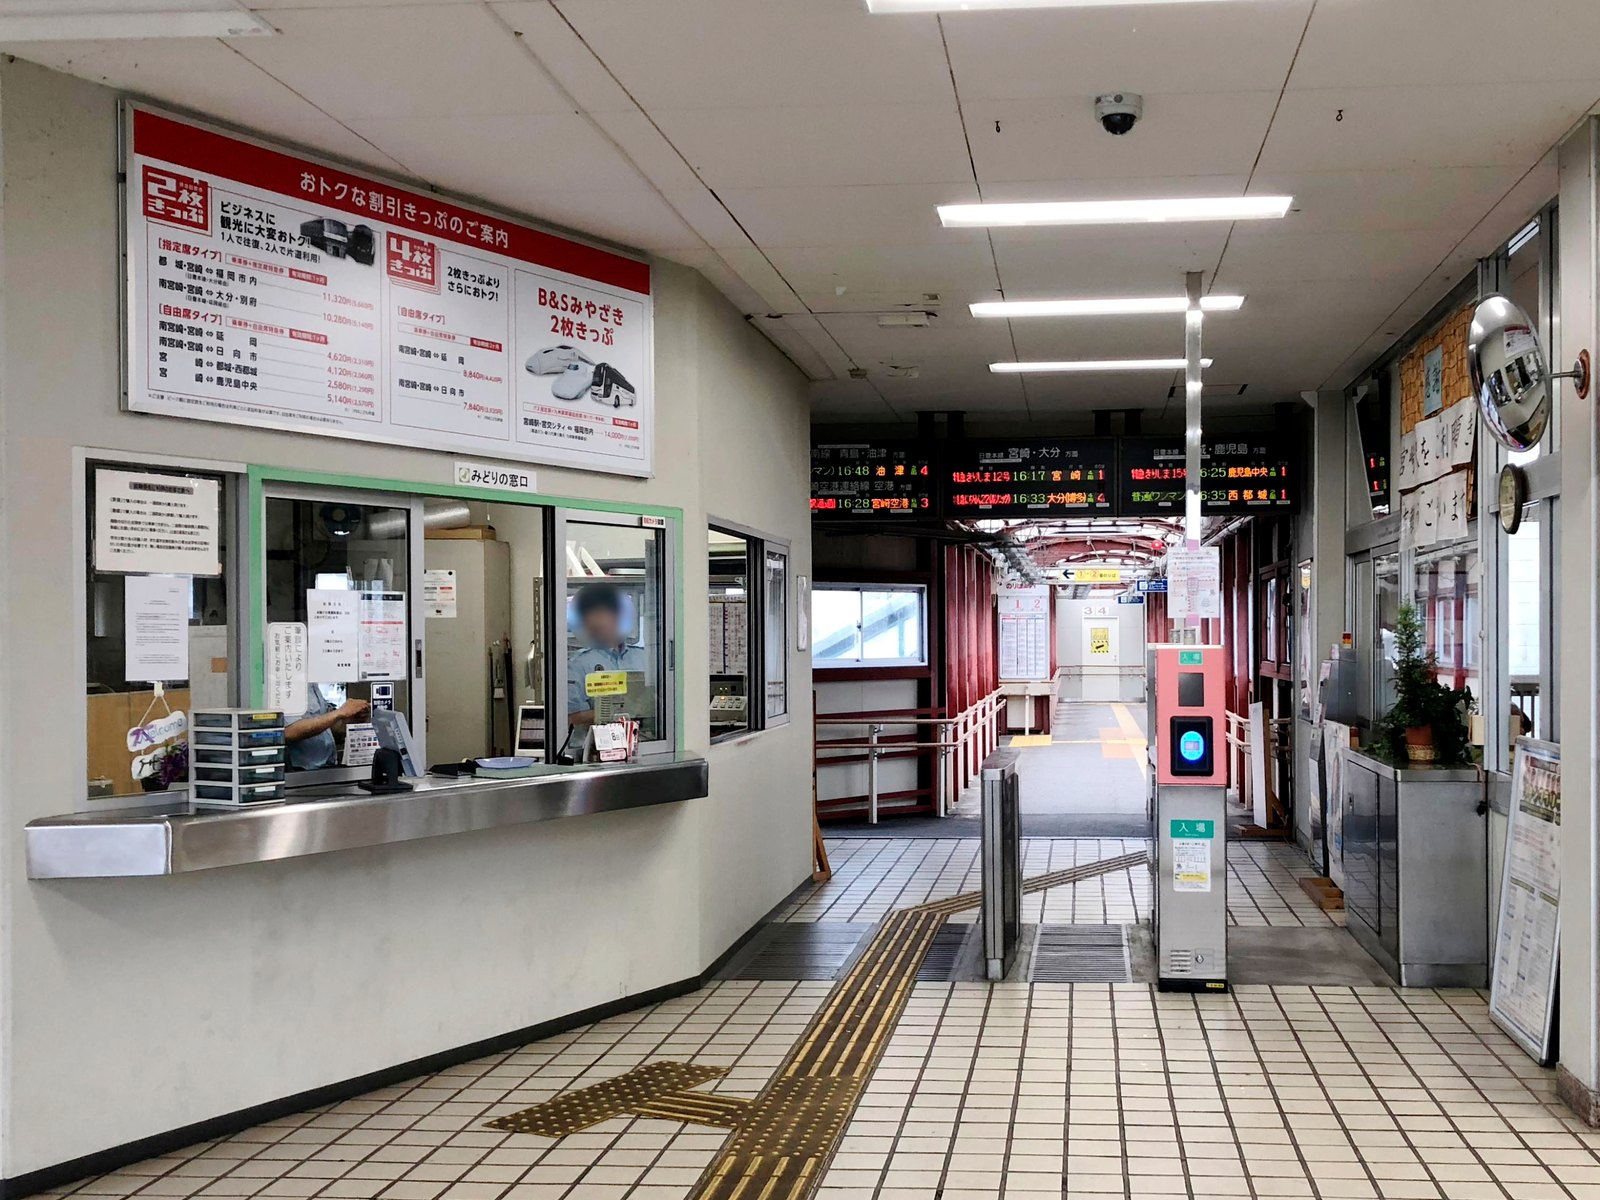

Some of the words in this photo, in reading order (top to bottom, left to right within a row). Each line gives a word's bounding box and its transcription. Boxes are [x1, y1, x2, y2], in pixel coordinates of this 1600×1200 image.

[220, 200, 276, 226] ビジネスに
[300, 171, 509, 249] おトクな割引きっぷのご案内
[220, 214, 311, 248] 観光に大変おトク!
[447, 265, 501, 289] 2枚きっぷより
[447, 280, 499, 302] さらにおトク!
[538, 287, 624, 327] B&Sみやざき
[550, 314, 615, 346] 2枚きっぷ
[216, 376, 258, 392] 鹿児島中央
[1008, 447, 1061, 460] 宮崎・大分
[838, 465, 870, 476] 16:48
[920, 464, 929, 476] 4
[1013, 470, 1047, 482] 16:17
[1051, 470, 1082, 482] 宮崎
[1098, 469, 1106, 481] 1
[1199, 467, 1227, 478] 6:25
[1228, 466, 1269, 479] 鹿児島中央
[1281, 466, 1287, 477] 1
[471, 469, 528, 488] みどりの窓口
[1013, 493, 1047, 505] 16:33
[1199, 490, 1227, 501] 6:35
[1281, 489, 1287, 500] 1
[838, 498, 870, 509] 16:28
[871, 498, 910, 510] 宮崎空港
[920, 498, 929, 509] 3
[1015, 599, 1021, 609] 1
[1034, 599, 1040, 609] 2
[1084, 606, 1093, 615] 3
[1098, 606, 1106, 615] 4
[1178, 822, 1206, 833] 入場
